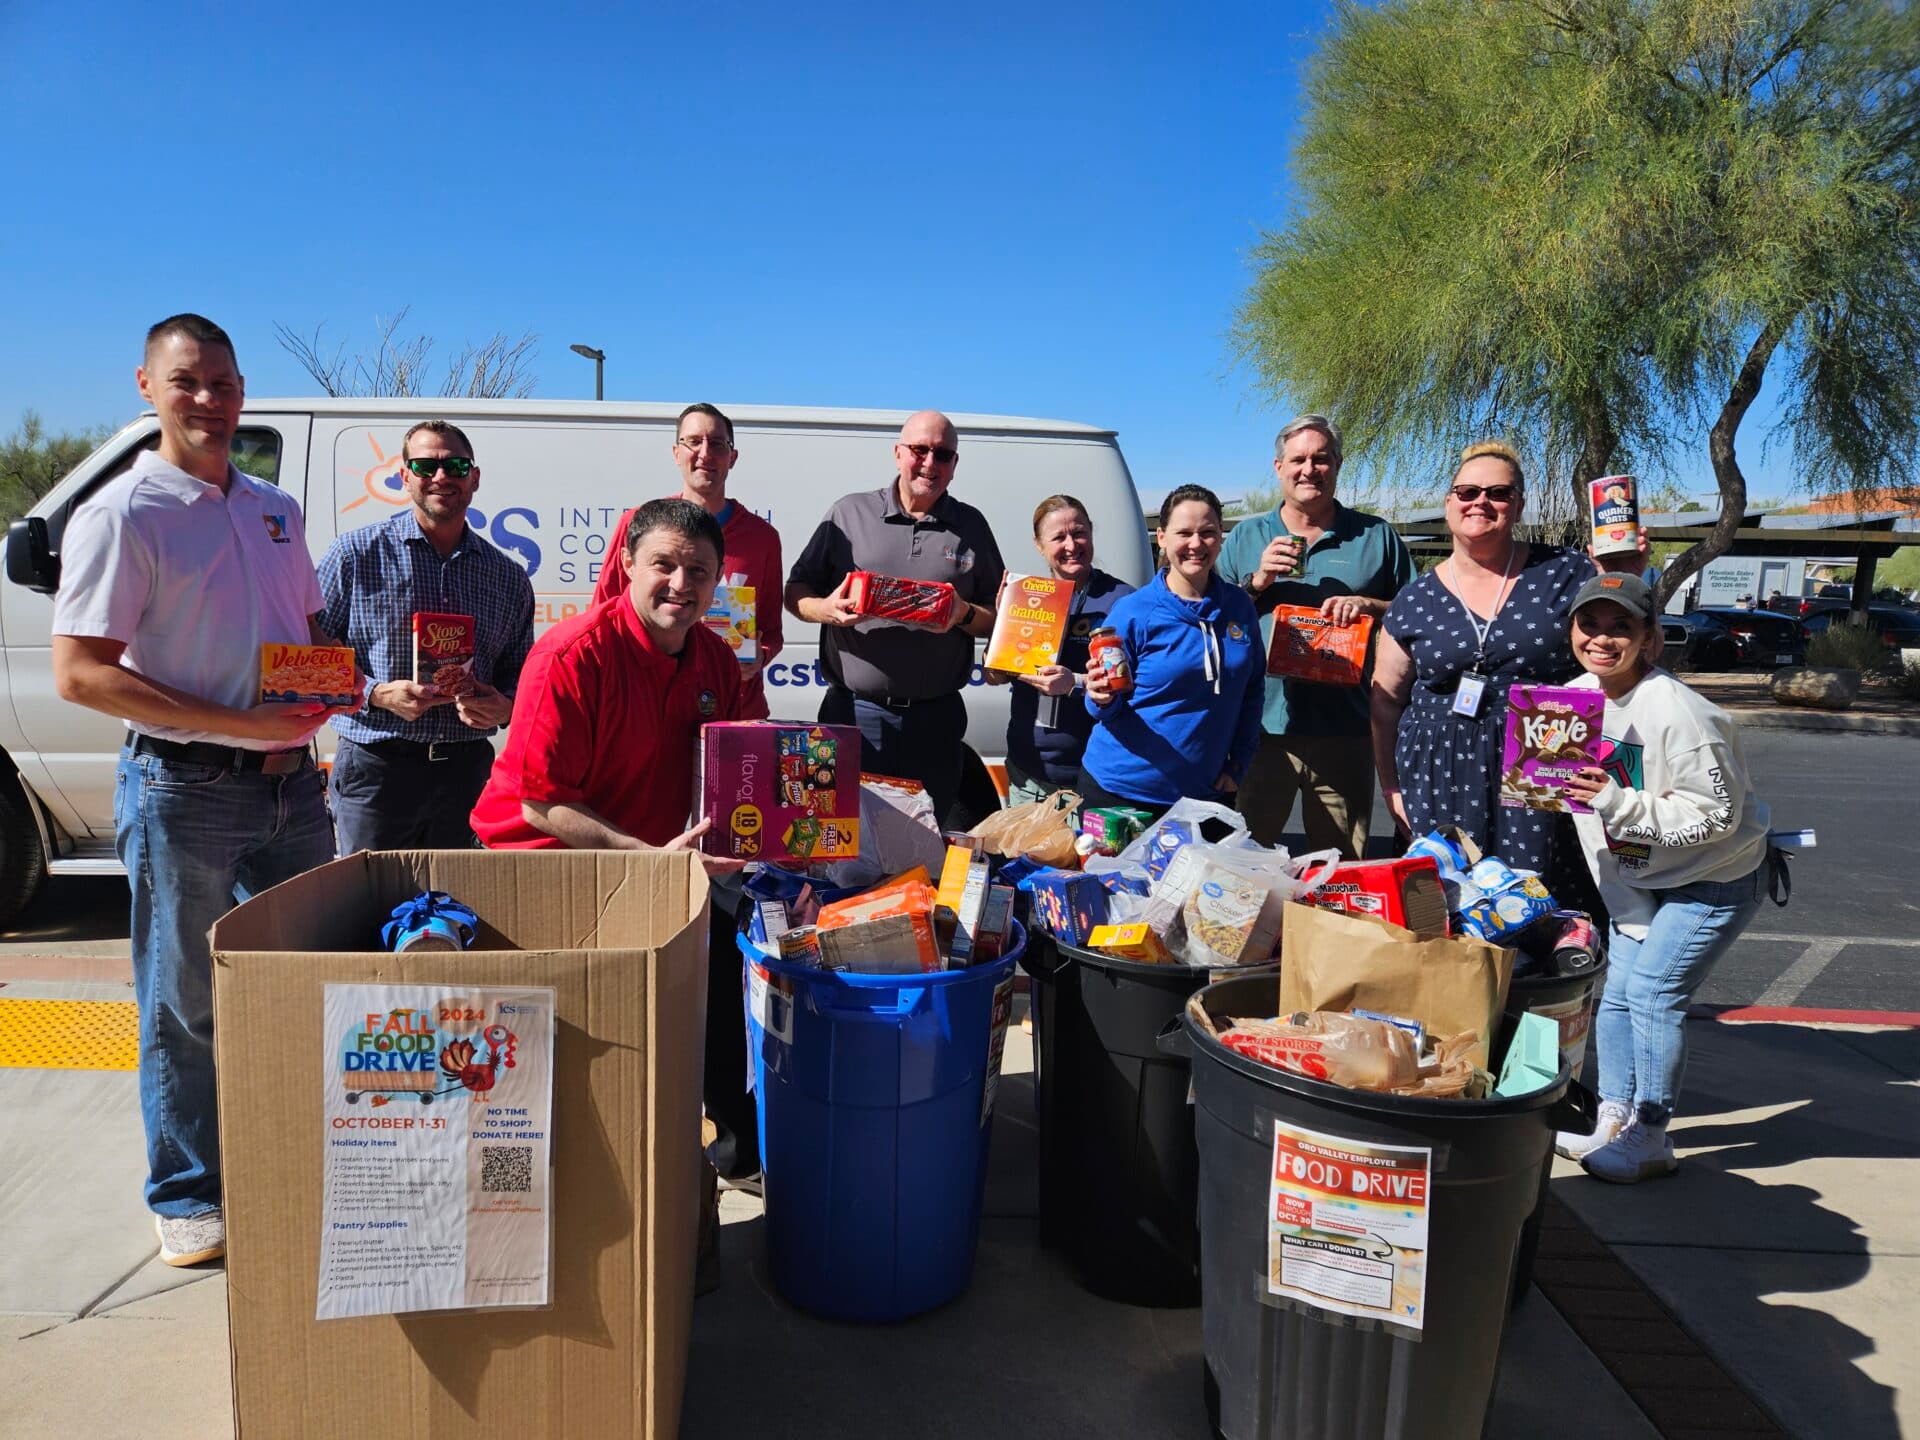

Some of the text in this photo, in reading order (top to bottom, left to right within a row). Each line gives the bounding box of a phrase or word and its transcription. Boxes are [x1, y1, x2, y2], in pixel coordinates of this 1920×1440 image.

[1597, 506, 1634, 520] QUAKER
[1605, 514, 1628, 524] OATS
[1022, 580, 1056, 594] Cheerios
[1008, 603, 1056, 624] Grandpa
[421, 622, 466, 648] Stove
[436, 640, 460, 655] Top
[272, 646, 346, 670] Velveeta
[1538, 702, 1574, 714] Kellogg's
[742, 753, 759, 802] flavor
[792, 780, 801, 804] Fritos
[741, 811, 758, 828] 18
[740, 836, 758, 854] +2
[827, 824, 836, 853] FREE
[837, 832, 852, 845] 2
[1320, 883, 1359, 893] Maruchan
[1210, 900, 1244, 918] Chicken
[440, 1008, 486, 1022] 2024
[366, 1013, 436, 1035] FALL
[358, 1033, 436, 1052] FOOD
[1271, 1038, 1318, 1051] STORES
[344, 1052, 436, 1072] DRIVE
[488, 1108, 528, 1116] NO TIME
[332, 1118, 446, 1130] OCTOBER 1-31
[500, 1120, 532, 1128] SHOP?
[516, 1132, 544, 1140] HERE!
[332, 1139, 368, 1148] Holiday
[1298, 1142, 1397, 1168] ORO VALLEY EMPLOYEE
[1279, 1150, 1425, 1200] FOOD DRIVE
[1279, 1204, 1312, 1217] THROUGH
[1286, 1198, 1305, 1209] NOW
[1278, 1212, 1298, 1222] OCT.
[333, 1220, 408, 1231] Pantry Supplies
[1284, 1236, 1306, 1246] WHAT
[1307, 1240, 1324, 1248] CAN
[1328, 1244, 1365, 1258] DONATE?
